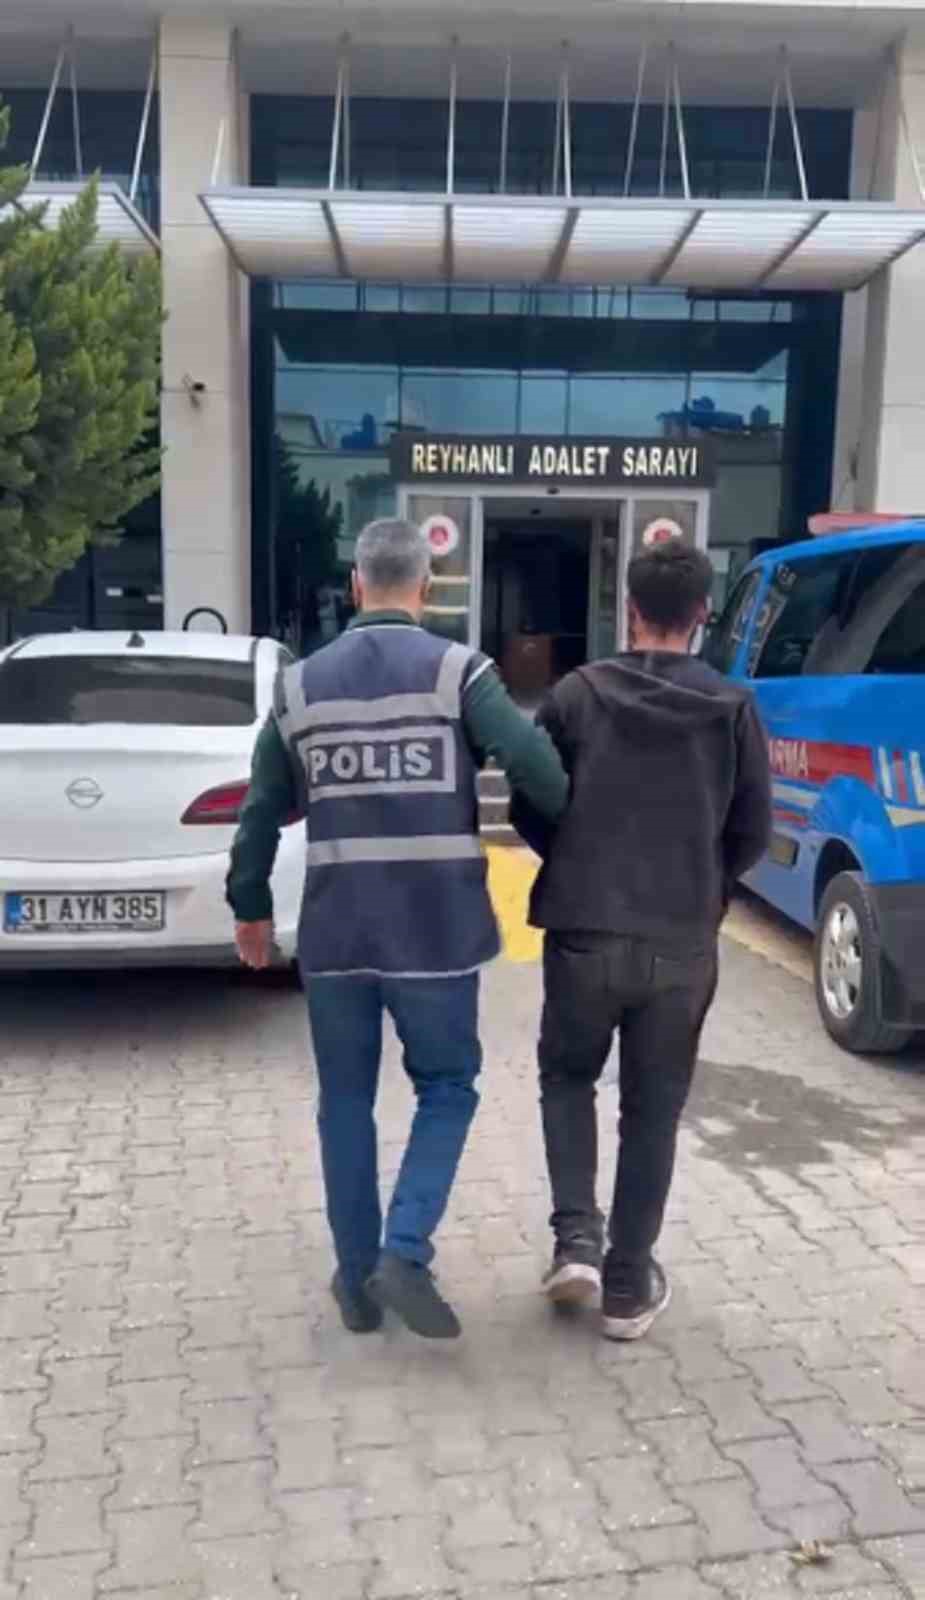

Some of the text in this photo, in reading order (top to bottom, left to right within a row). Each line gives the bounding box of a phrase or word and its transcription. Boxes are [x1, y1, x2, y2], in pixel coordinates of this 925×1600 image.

[412, 443, 698, 477] REYHANLI ADALET SARAYI
[22, 896, 48, 921] 31
[111, 895, 158, 920] 385
